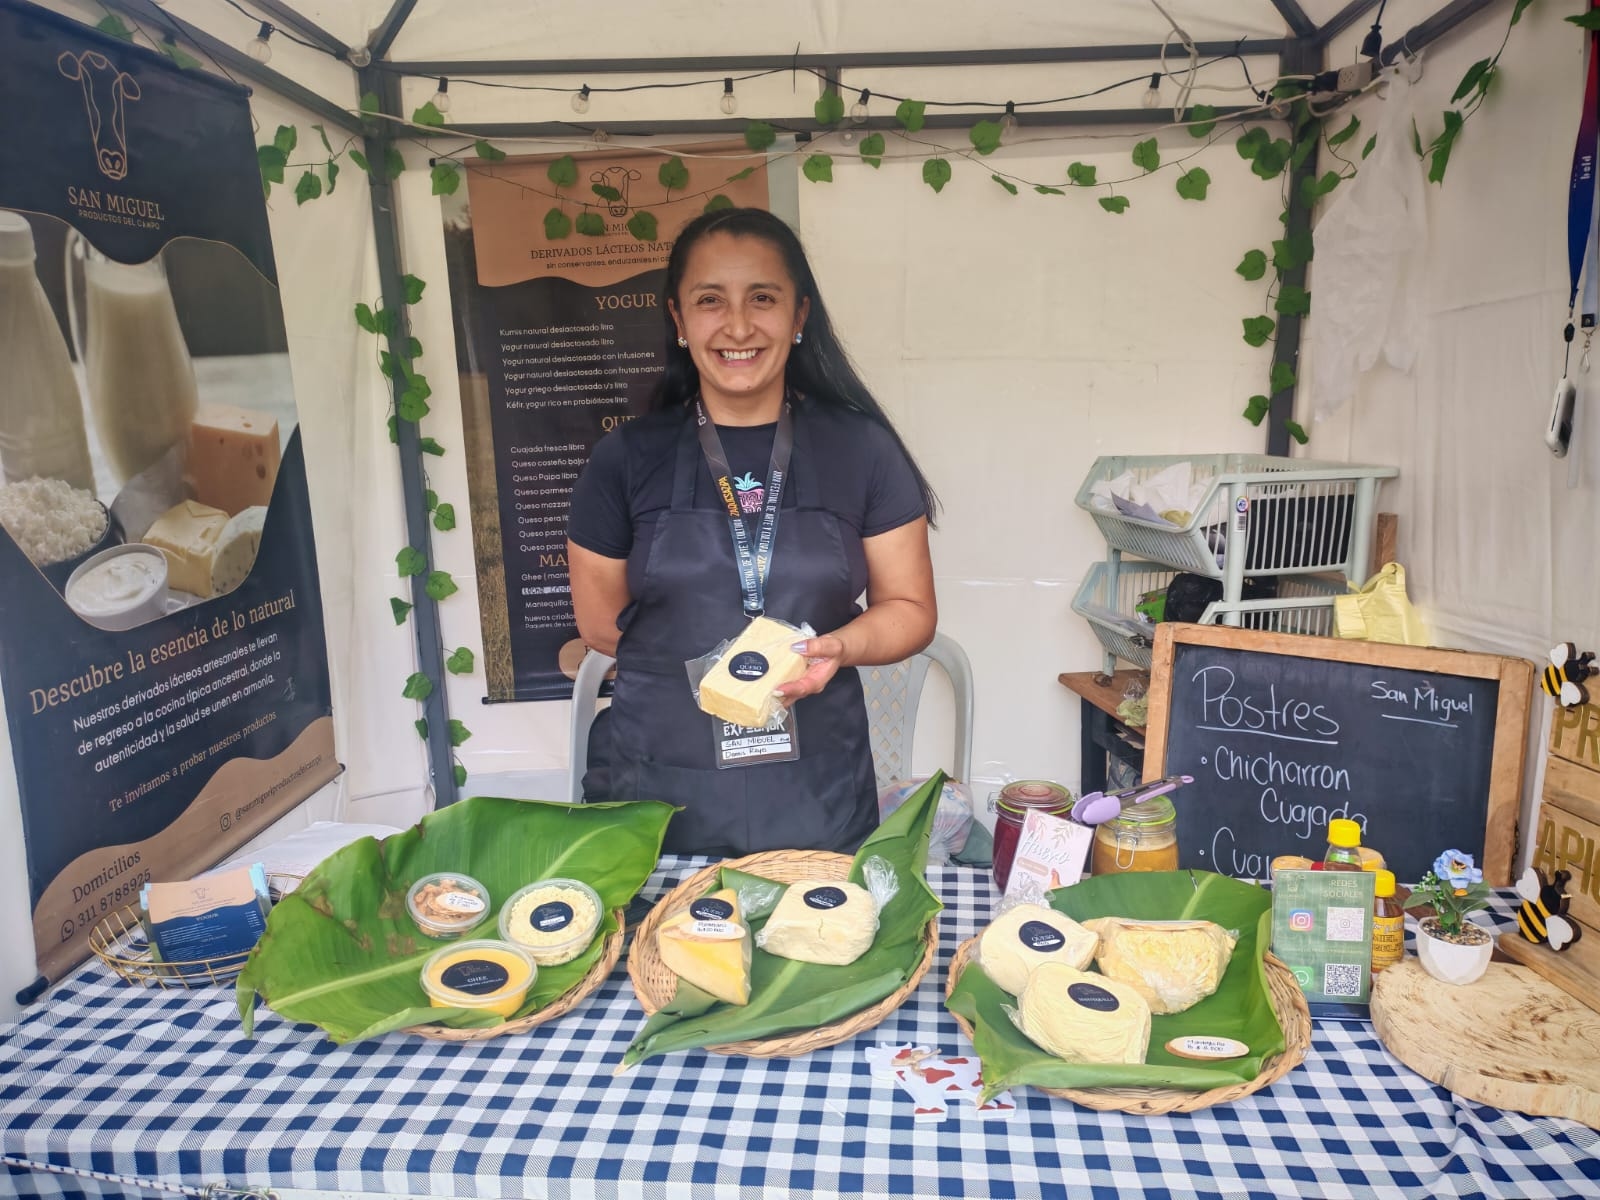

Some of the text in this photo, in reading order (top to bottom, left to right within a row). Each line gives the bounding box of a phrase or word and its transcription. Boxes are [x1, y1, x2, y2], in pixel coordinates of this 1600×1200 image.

[67, 186, 165, 221] SAN MIGUEL
[78, 210, 160, 230] PRODUCTOS DEL CAMPO
[530, 246, 593, 260] DERIVADOS
[596, 243, 645, 256] LÁCTEOS
[546, 262, 557, 270] sin
[594, 292, 658, 311] YOGUR
[499, 323, 614, 337] Kumis natural deslactosado litro
[500, 338, 615, 353] Yogur natural deslactosado litro
[502, 357, 524, 367] Yogur
[525, 356, 551, 364] natural
[551, 353, 601, 363] deslactosado
[617, 351, 655, 359] infusiones
[503, 372, 525, 382] Yogur
[526, 370, 552, 379] natural
[553, 367, 603, 378] deslactosado
[618, 366, 640, 374] frutas
[640, 366, 665, 374] natura
[505, 386, 526, 396] Yogur
[527, 385, 552, 395] griego
[552, 381, 603, 393] deslactosado
[614, 381, 629, 390] litro
[525, 401, 547, 410] yogur
[614, 396, 629, 405] litro
[510, 443, 585, 454] Cuajada fresca libra
[511, 460, 537, 469] Queso
[537, 459, 568, 467] costeño
[567, 458, 585, 467] bajo
[512, 472, 579, 483] Queso Paipa libra
[513, 487, 574, 497] Queso parmesa
[767, 482, 781, 504] FESTIVAL
[515, 502, 540, 511] Queso
[766, 505, 777, 513] DE
[517, 516, 543, 525] Queso
[543, 516, 561, 524] pera
[762, 513, 775, 527] ARTE
[518, 530, 544, 539] Queso
[544, 529, 563, 539] para
[733, 518, 746, 540] CULTURA
[519, 544, 545, 553] Queso
[546, 543, 564, 552] para
[758, 531, 772, 553] CULTURA
[738, 544, 751, 558] ARTE
[742, 558, 753, 567] DE
[521, 573, 543, 582] Ghee
[744, 567, 757, 592] FESTIVAL
[525, 600, 568, 608] Mantequilla
[29, 588, 296, 714] Descubre la esencia de lo natural
[73, 632, 278, 733] Nuestros derivados lácteos artesanales te llevan
[77, 650, 281, 756] de regreso a la cocina típica ancestral, donde la
[1192, 665, 1340, 737] Postres
[1370, 680, 1474, 722] San Miguel
[94, 673, 275, 773] autenticidad y la salud se unen en armonía.
[725, 740, 743, 748] SAN
[747, 735, 775, 745] MIGUEL
[108, 710, 278, 813] Te invitamos a probar nuestros productos
[1214, 745, 1351, 792] Chicharron
[72, 850, 142, 904] Domicilios
[1330, 879, 1358, 888] REDES
[78, 904, 98, 927] 311
[100, 867, 151, 912] 8788925
[1322, 888, 1364, 899] SOCIALES
